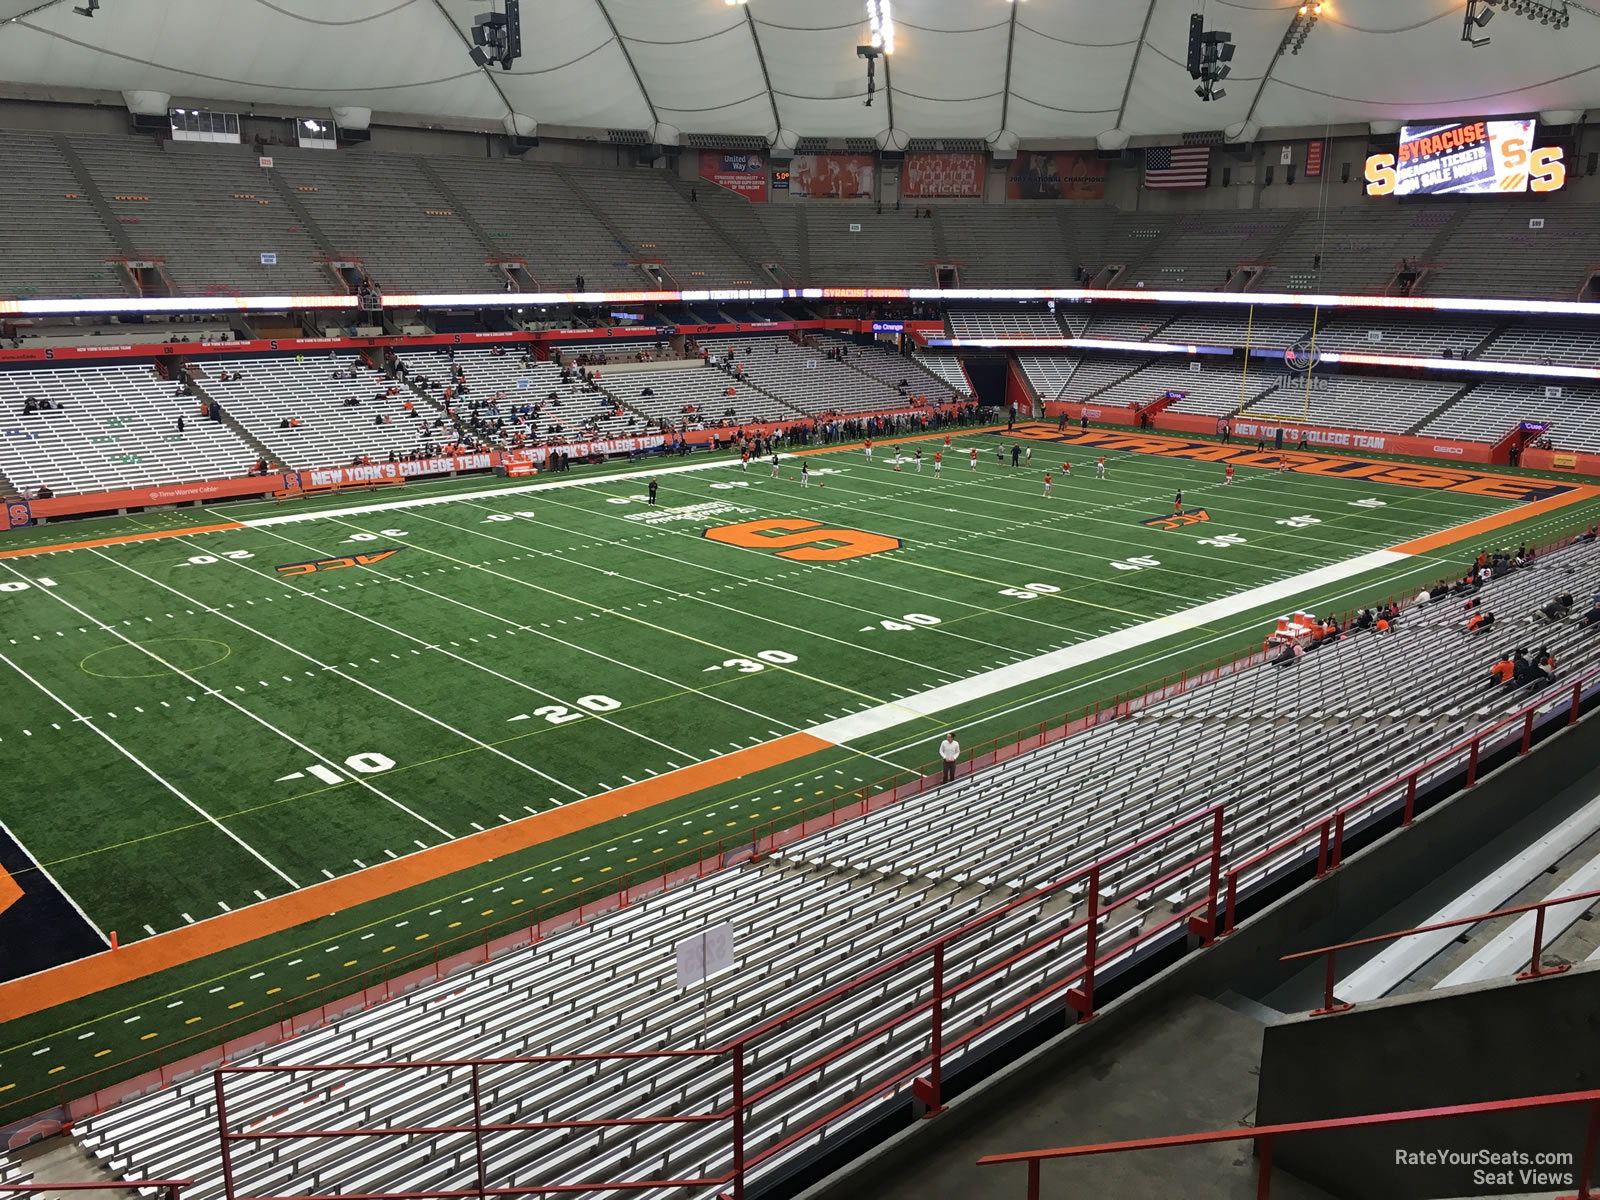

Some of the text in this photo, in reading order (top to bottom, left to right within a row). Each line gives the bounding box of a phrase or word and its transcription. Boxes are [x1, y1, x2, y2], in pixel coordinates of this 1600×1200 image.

[1399, 122, 1486, 162] SYRACUSE
[724, 155, 746, 163] United
[1441, 146, 1486, 169] TICKETS
[1501, 138, 1528, 168] S
[732, 163, 747, 171] Way
[1365, 153, 1397, 196] S
[1421, 168, 1452, 188] SALE
[1453, 157, 1488, 179] NOW!
[1529, 146, 1567, 192] S
[824, 289, 908, 297] SYRACUSE FOOTBALL
[883, 323, 904, 331] Orange
[45, 348, 54, 359] S
[270, 340, 278, 350] S
[1271, 375, 1328, 390] Allstate
[591, 438, 635, 454] COLLEGE
[637, 435, 664, 450] TEAM
[1235, 423, 1258, 436] NEW
[1260, 426, 1299, 440] YOK'S
[1353, 435, 1385, 449] TEAM
[1433, 446, 1464, 454] GEICO
[311, 453, 490, 486] NEW YORK'S COLLEGE TEAM
[1002, 424, 1557, 499] SYRACUSE
[175, 488, 198, 496] Warner
[1347, 497, 1387, 508] 10
[10, 504, 29, 526] S
[487, 511, 535, 522] 40
[1139, 507, 1211, 531] ACC
[1274, 514, 1322, 528] 20
[349, 529, 409, 542] 30
[702, 518, 903, 561] S
[1197, 533, 1247, 547] 30
[188, 549, 256, 566] 20
[274, 547, 408, 577] ACC
[1110, 556, 1160, 571] 40
[998, 583, 1061, 599] 50
[880, 613, 942, 631] 40
[722, 650, 798, 673] 30
[533, 694, 622, 724] 20
[305, 752, 397, 785] 10
